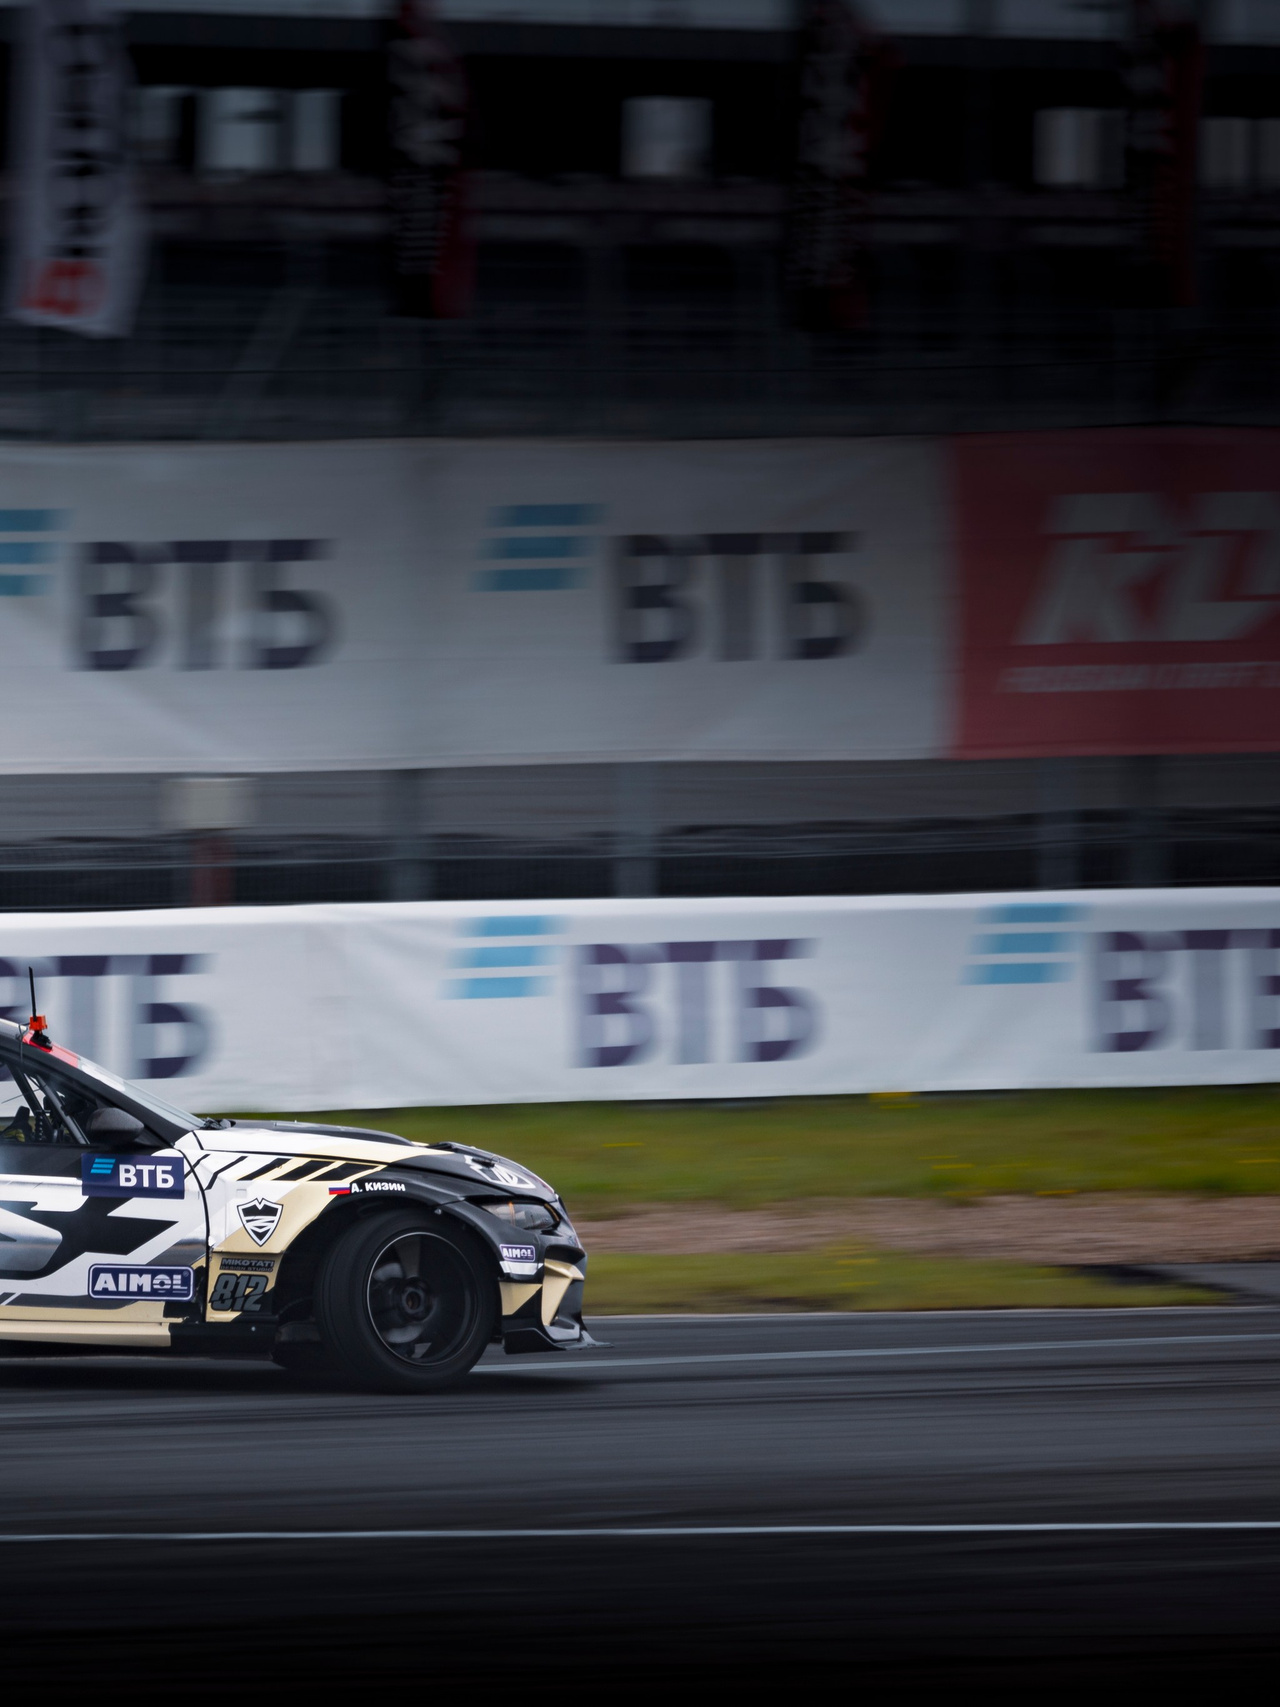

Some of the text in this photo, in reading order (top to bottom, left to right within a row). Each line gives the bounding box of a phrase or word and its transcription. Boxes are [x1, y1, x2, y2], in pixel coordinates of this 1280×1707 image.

[68, 538, 342, 671] ВТБ
[608, 532, 872, 664] ВТБ
[572, 939, 823, 1068] ВТБ
[119, 1164, 175, 1188] ВТБ
[364, 1182, 406, 1192] КИЗИН
[221, 1259, 274, 1267] MIKOTATI
[502, 1247, 534, 1259] AIMOL
[94, 1273, 188, 1294] AIMOL
[210, 1273, 268, 1312] 812
